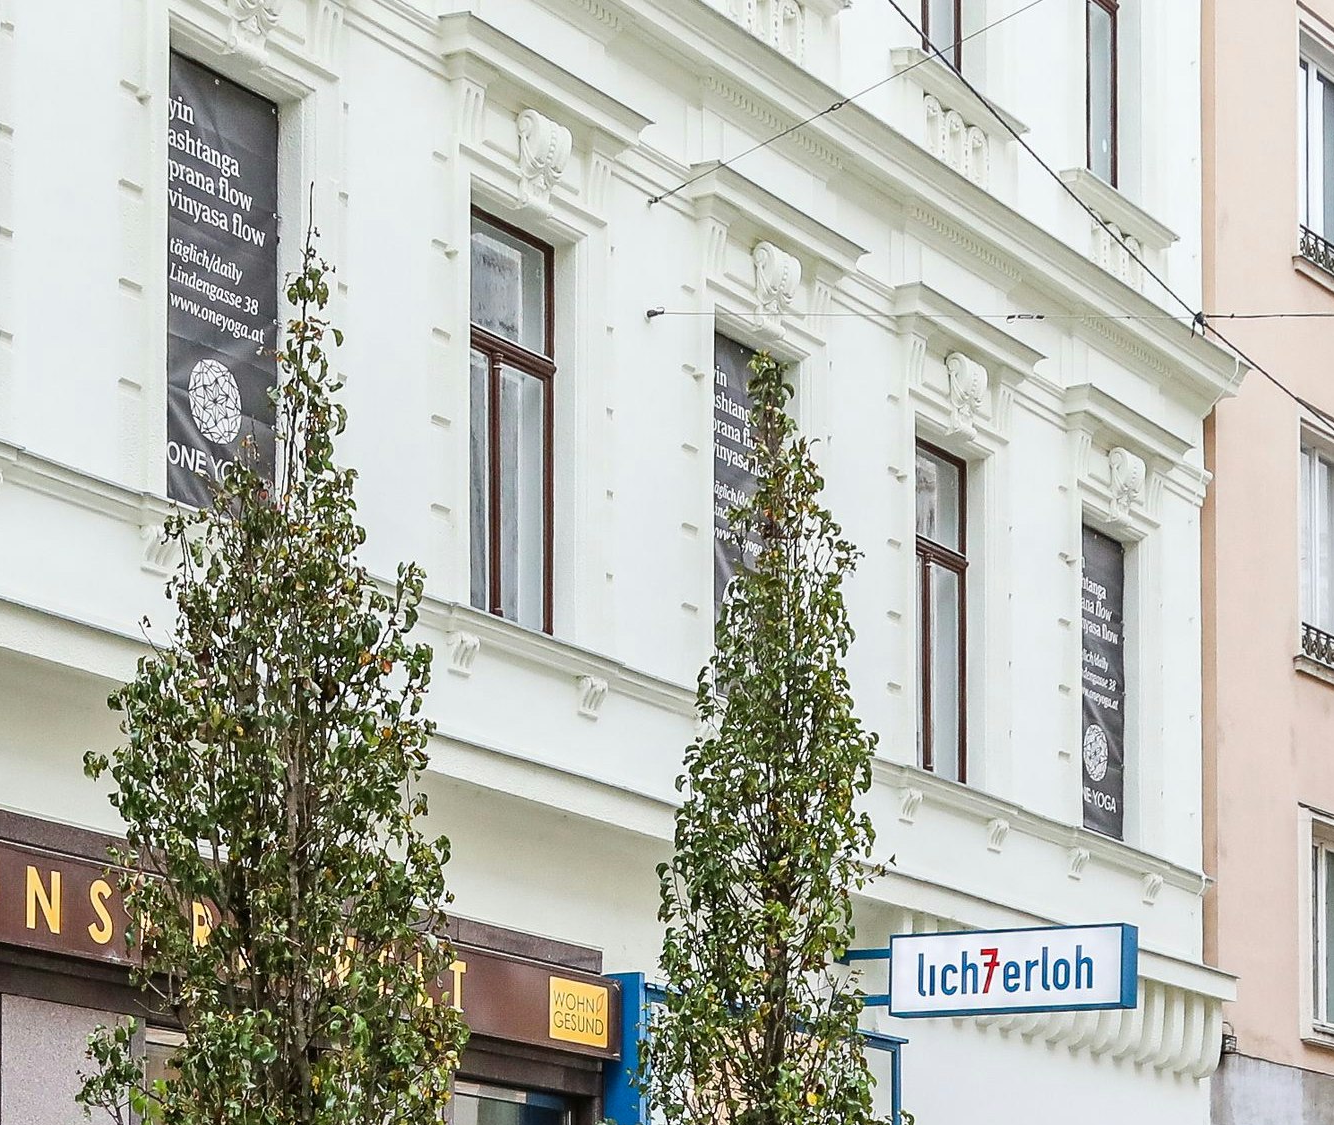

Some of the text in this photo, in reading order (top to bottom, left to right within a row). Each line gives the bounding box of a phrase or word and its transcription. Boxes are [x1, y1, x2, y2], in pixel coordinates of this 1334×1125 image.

[168, 96, 195, 126] yin
[168, 129, 241, 178] ashtanga
[168, 159, 253, 212] prana flow
[168, 187, 266, 248] vinyasa flow
[169, 237, 243, 286] täglich/daily
[169, 262, 260, 316] Lindengasse 38
[169, 291, 266, 345] www.oneyoga.at
[713, 365, 728, 388] in
[167, 441, 207, 475] ONE
[1092, 789, 1117, 814] YOGA
[553, 988, 596, 1014] WOHN
[553, 1011, 605, 1037] GESUND
